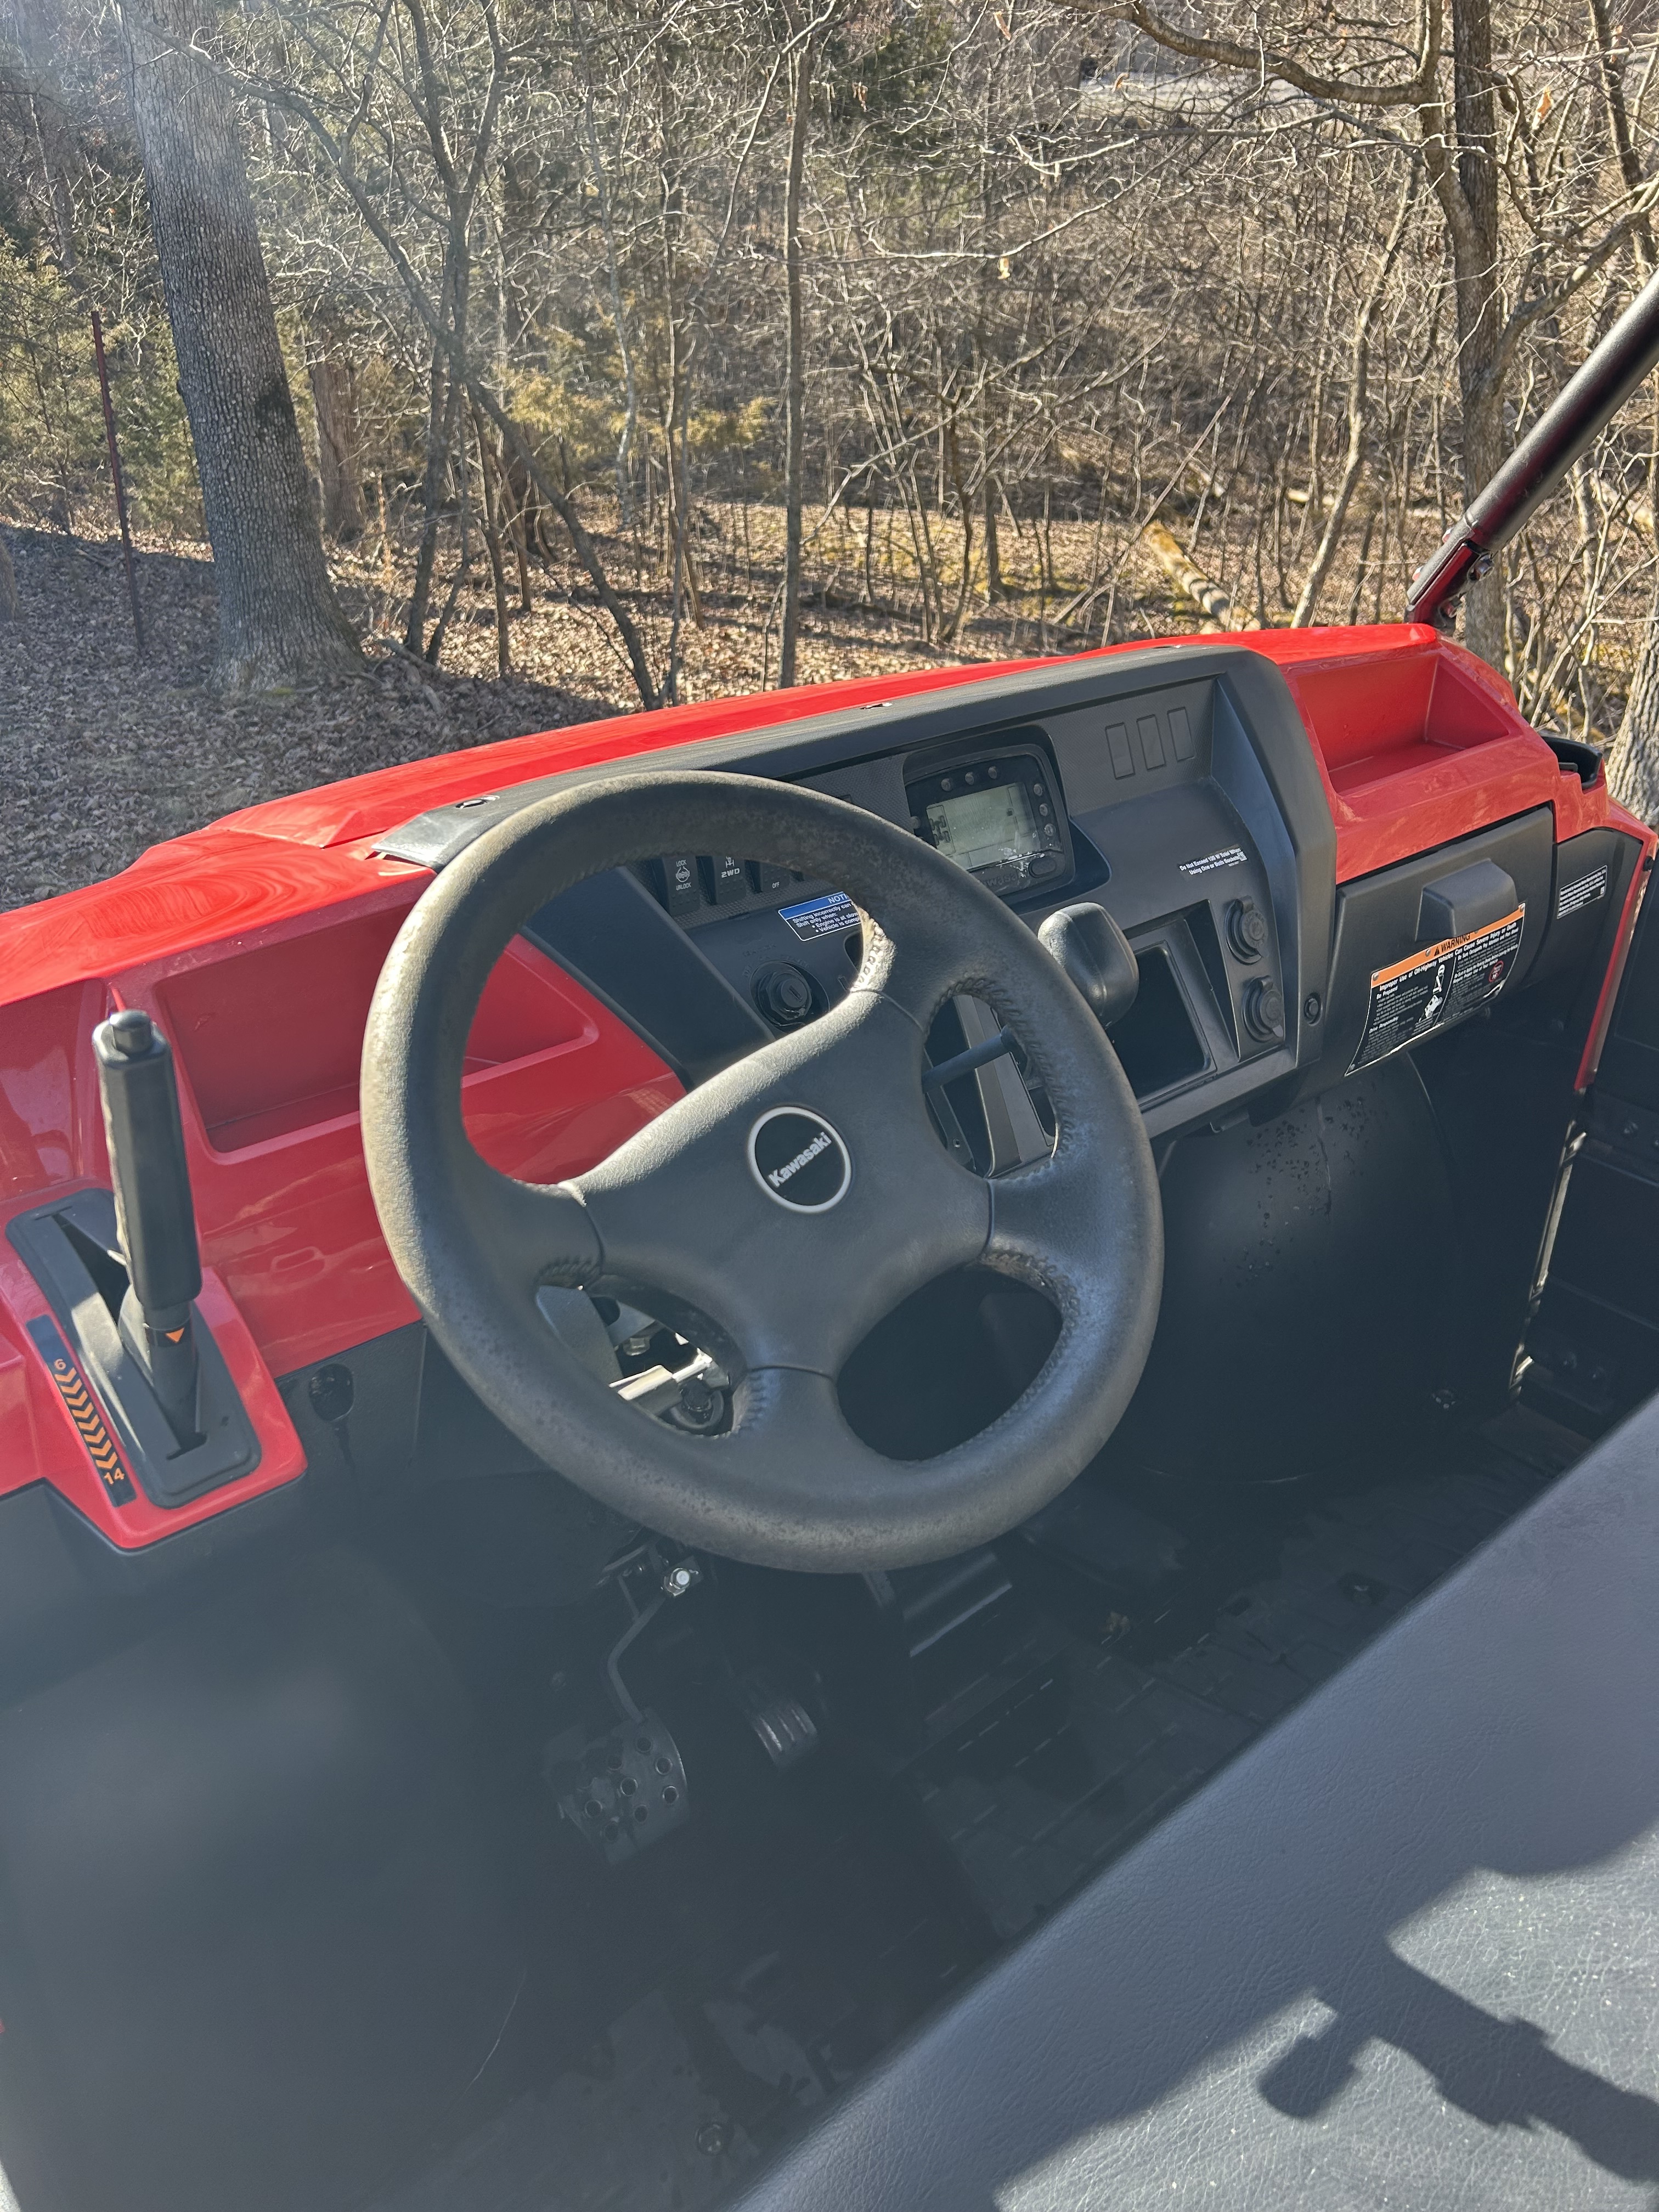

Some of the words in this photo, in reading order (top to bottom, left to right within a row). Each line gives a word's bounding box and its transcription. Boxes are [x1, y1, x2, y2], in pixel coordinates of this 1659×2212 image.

[676, 859, 687, 867] LOCK
[721, 868, 740, 878] 2WD
[676, 882, 691, 890] UNLOCK
[828, 894, 848, 904] NOTI
[792, 915, 814, 923] Shifting
[814, 906, 841, 917] incorrectly
[797, 919, 810, 928] Shift
[816, 918, 834, 928] Engine
[819, 923, 839, 932] Vehicle
[1441, 934, 1470, 953] WARNING
[768, 1132, 832, 1187] Kawasaki
[54, 1358, 66, 1370] 6
[104, 1468, 125, 1485] 14
